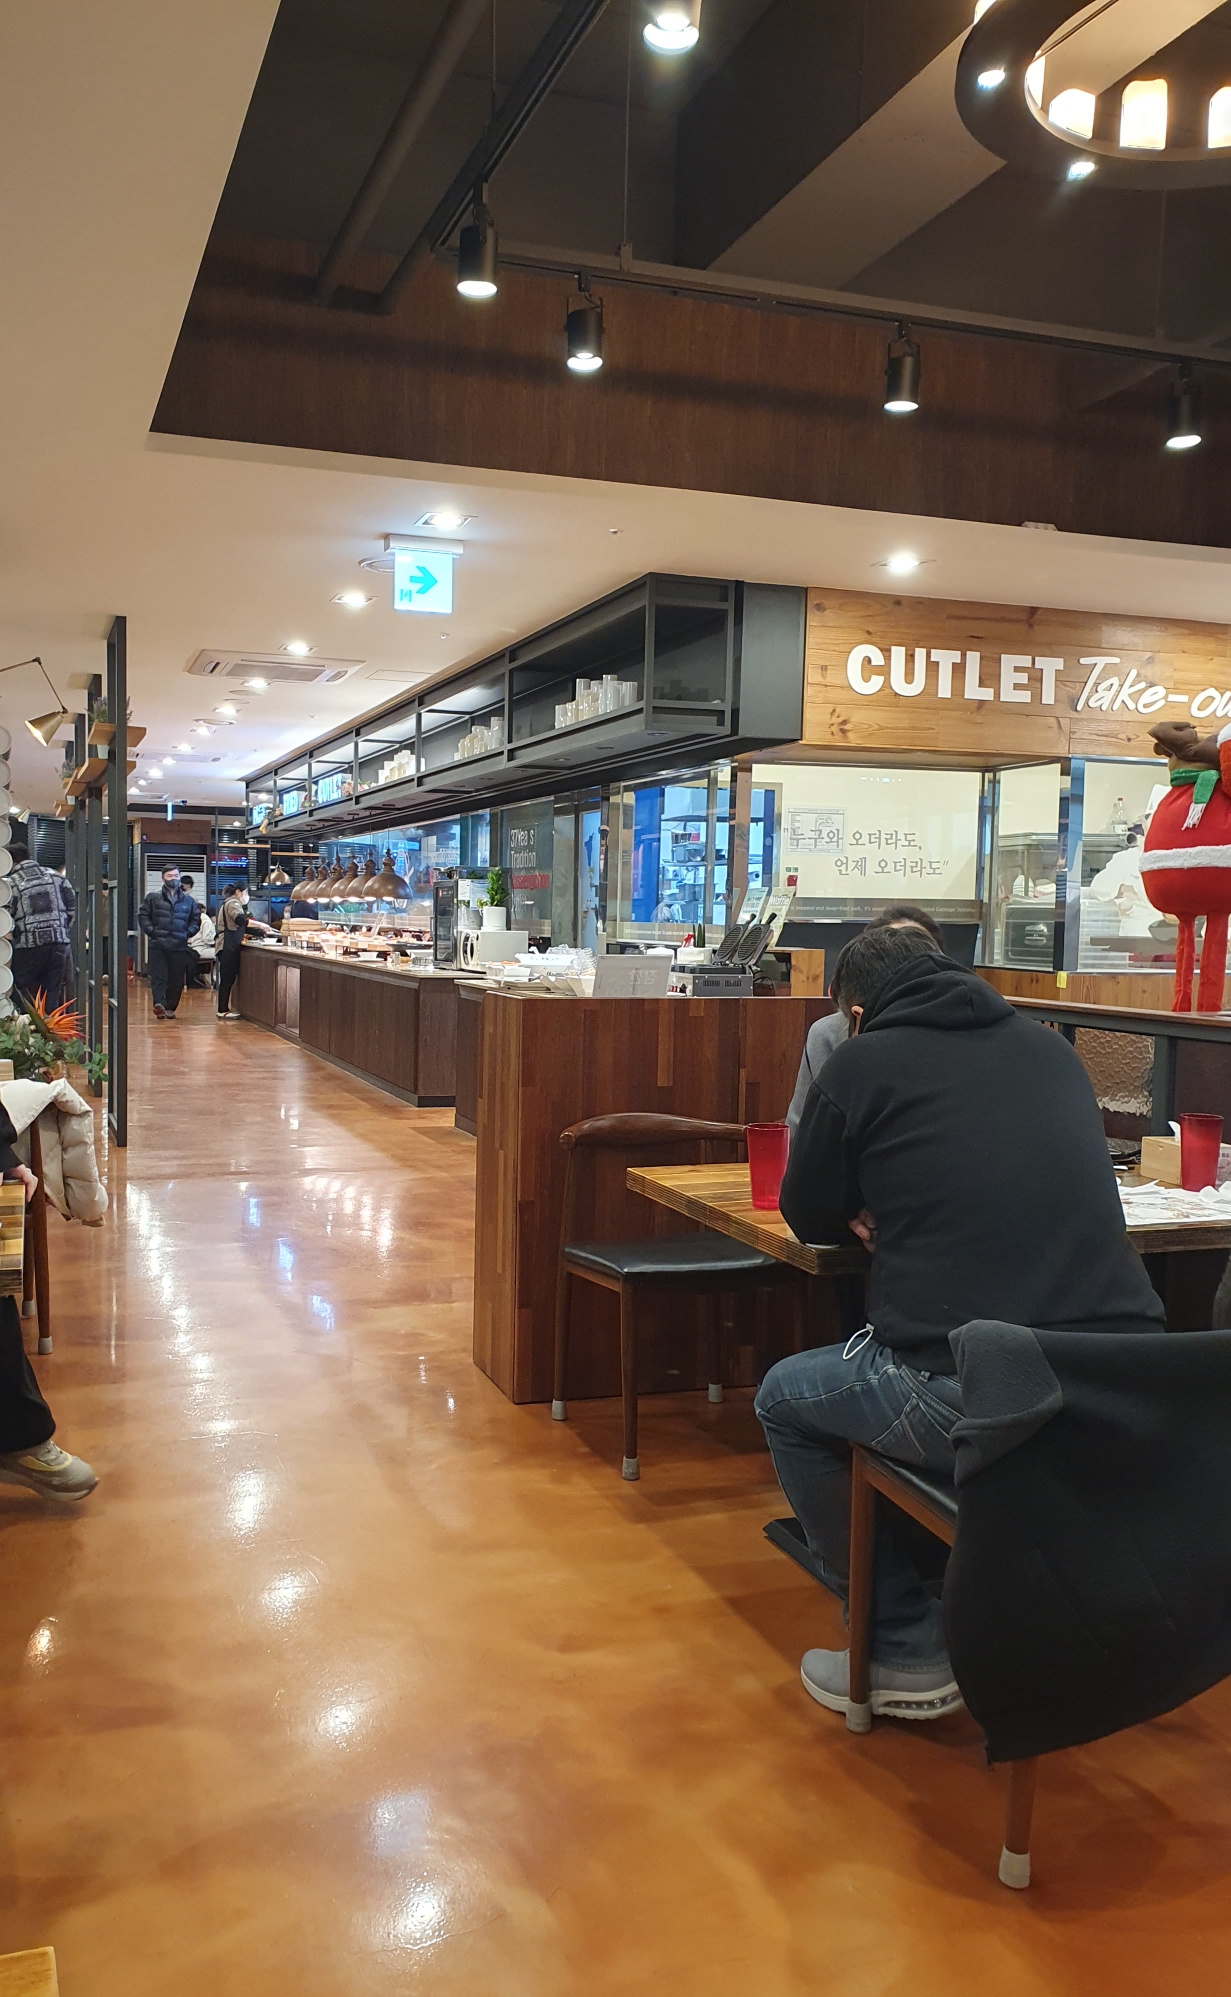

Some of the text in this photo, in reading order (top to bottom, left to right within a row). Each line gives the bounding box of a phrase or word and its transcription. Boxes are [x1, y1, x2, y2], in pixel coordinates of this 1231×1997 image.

[846, 643, 1064, 705] CUTLET
[848, 829, 923, 851] 오더라도,
[510, 850, 537, 868] Tradition
[834, 855, 949, 878] 언제 오더라도"
